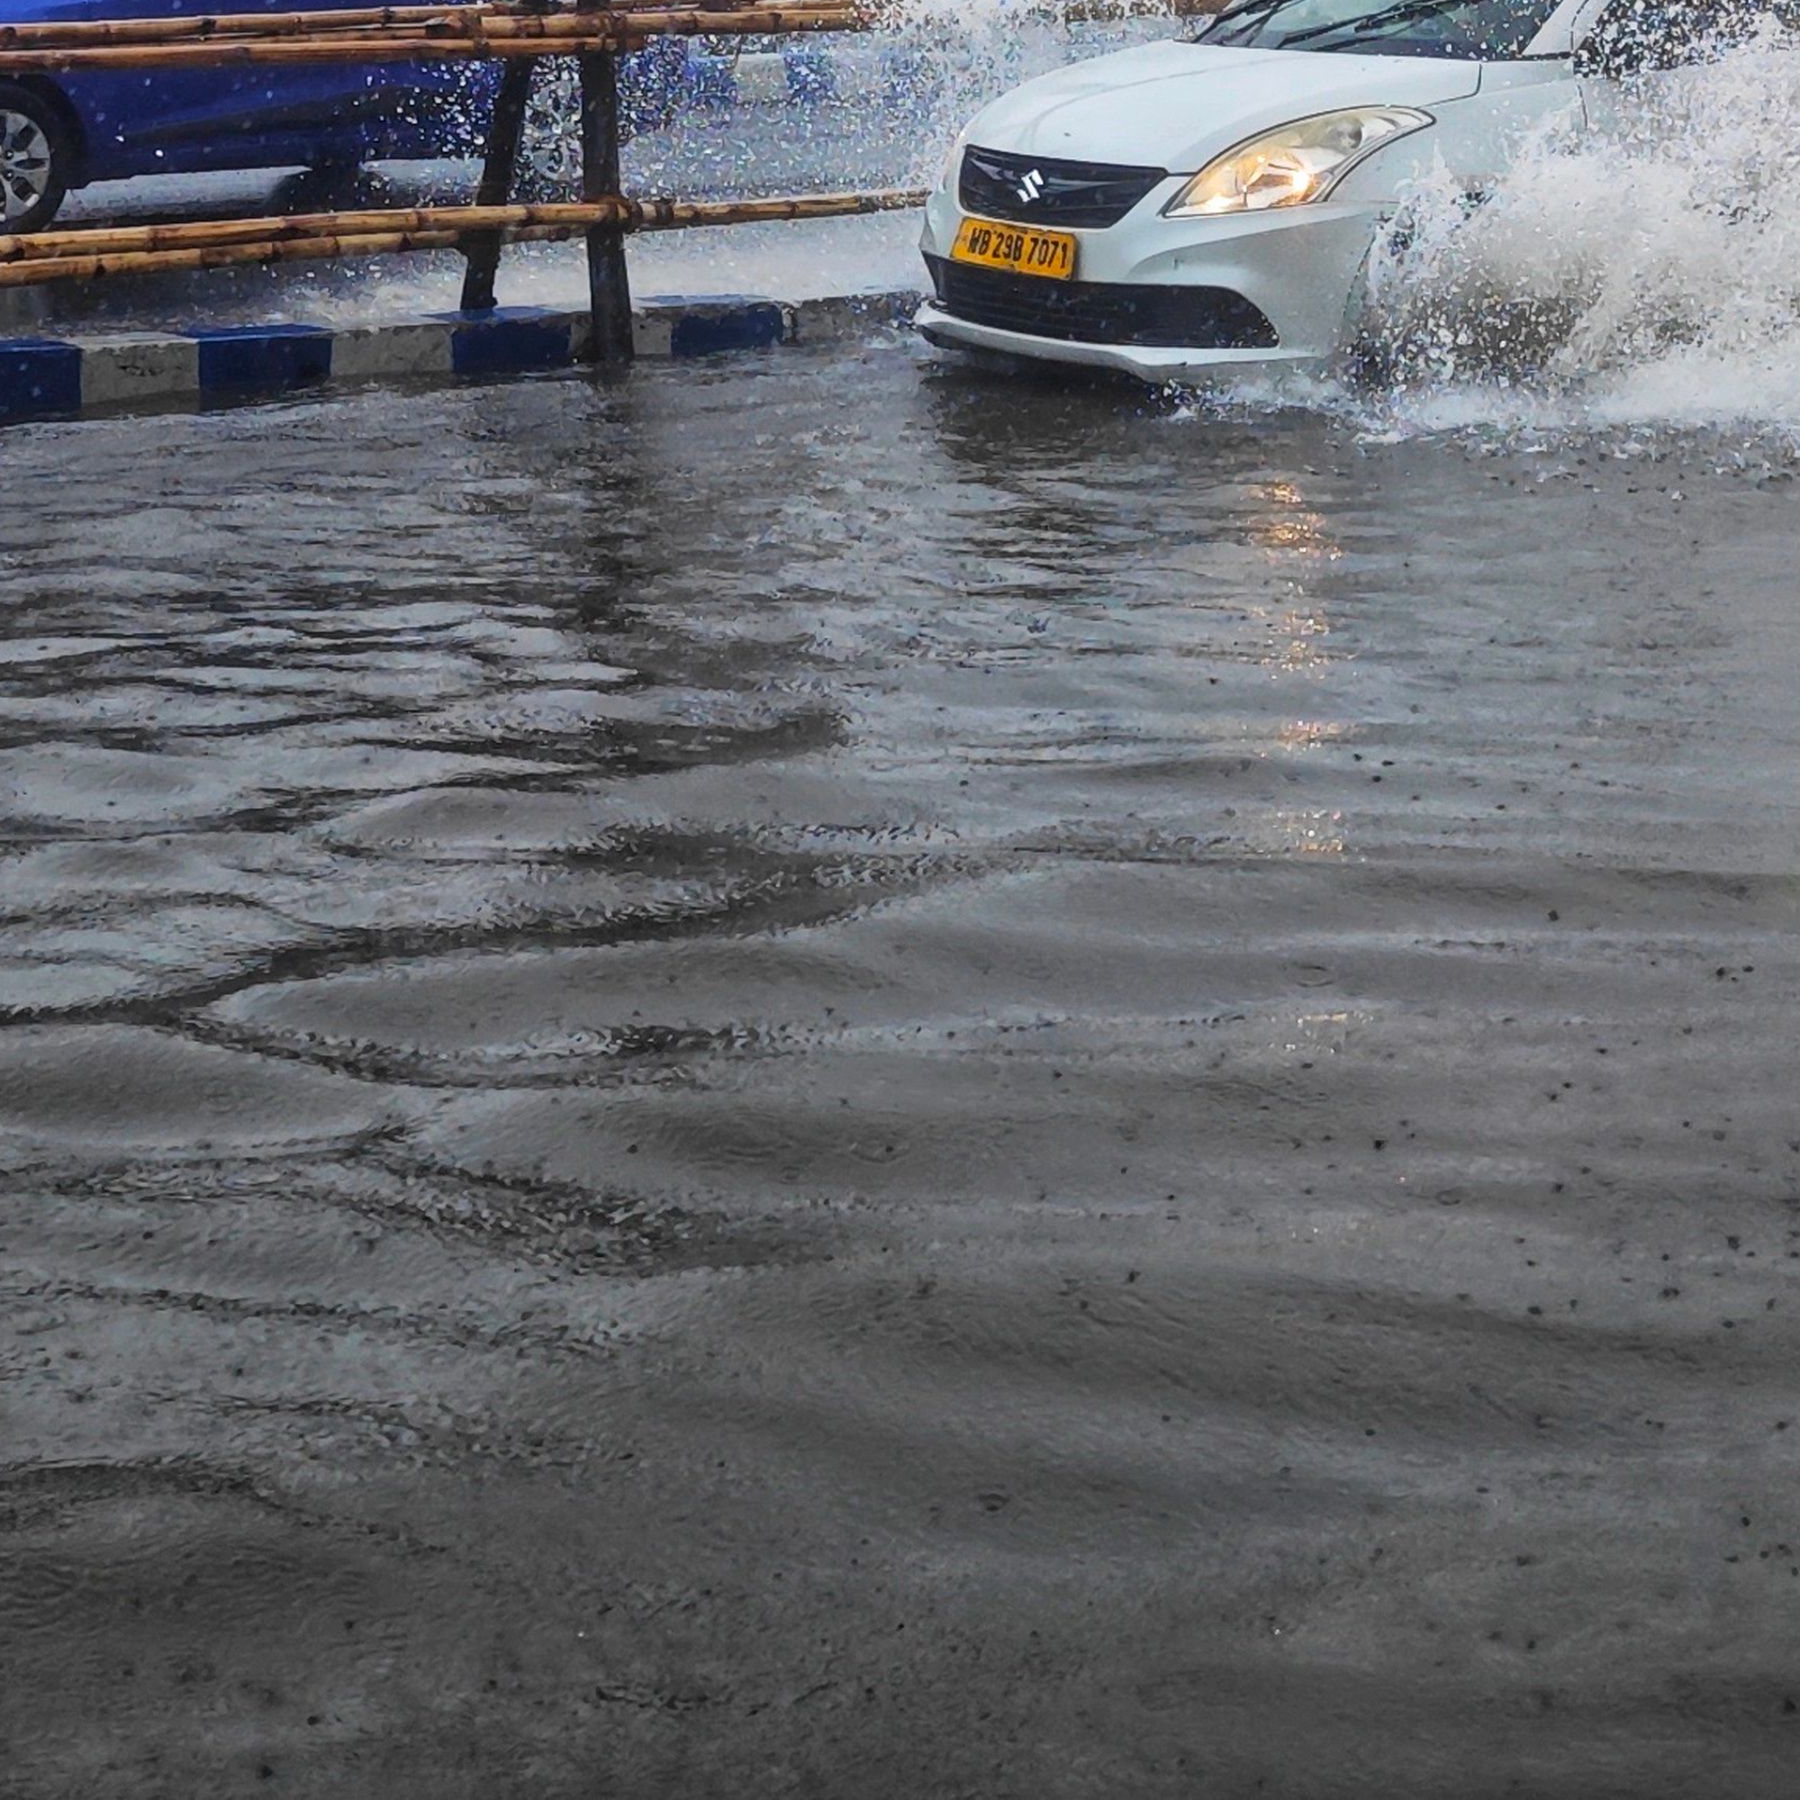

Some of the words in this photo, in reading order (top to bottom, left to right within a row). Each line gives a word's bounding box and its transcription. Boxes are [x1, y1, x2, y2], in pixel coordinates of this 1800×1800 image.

[968, 227, 991, 256] WB
[992, 232, 1025, 262] 29B
[1027, 237, 1068, 269] 7071
